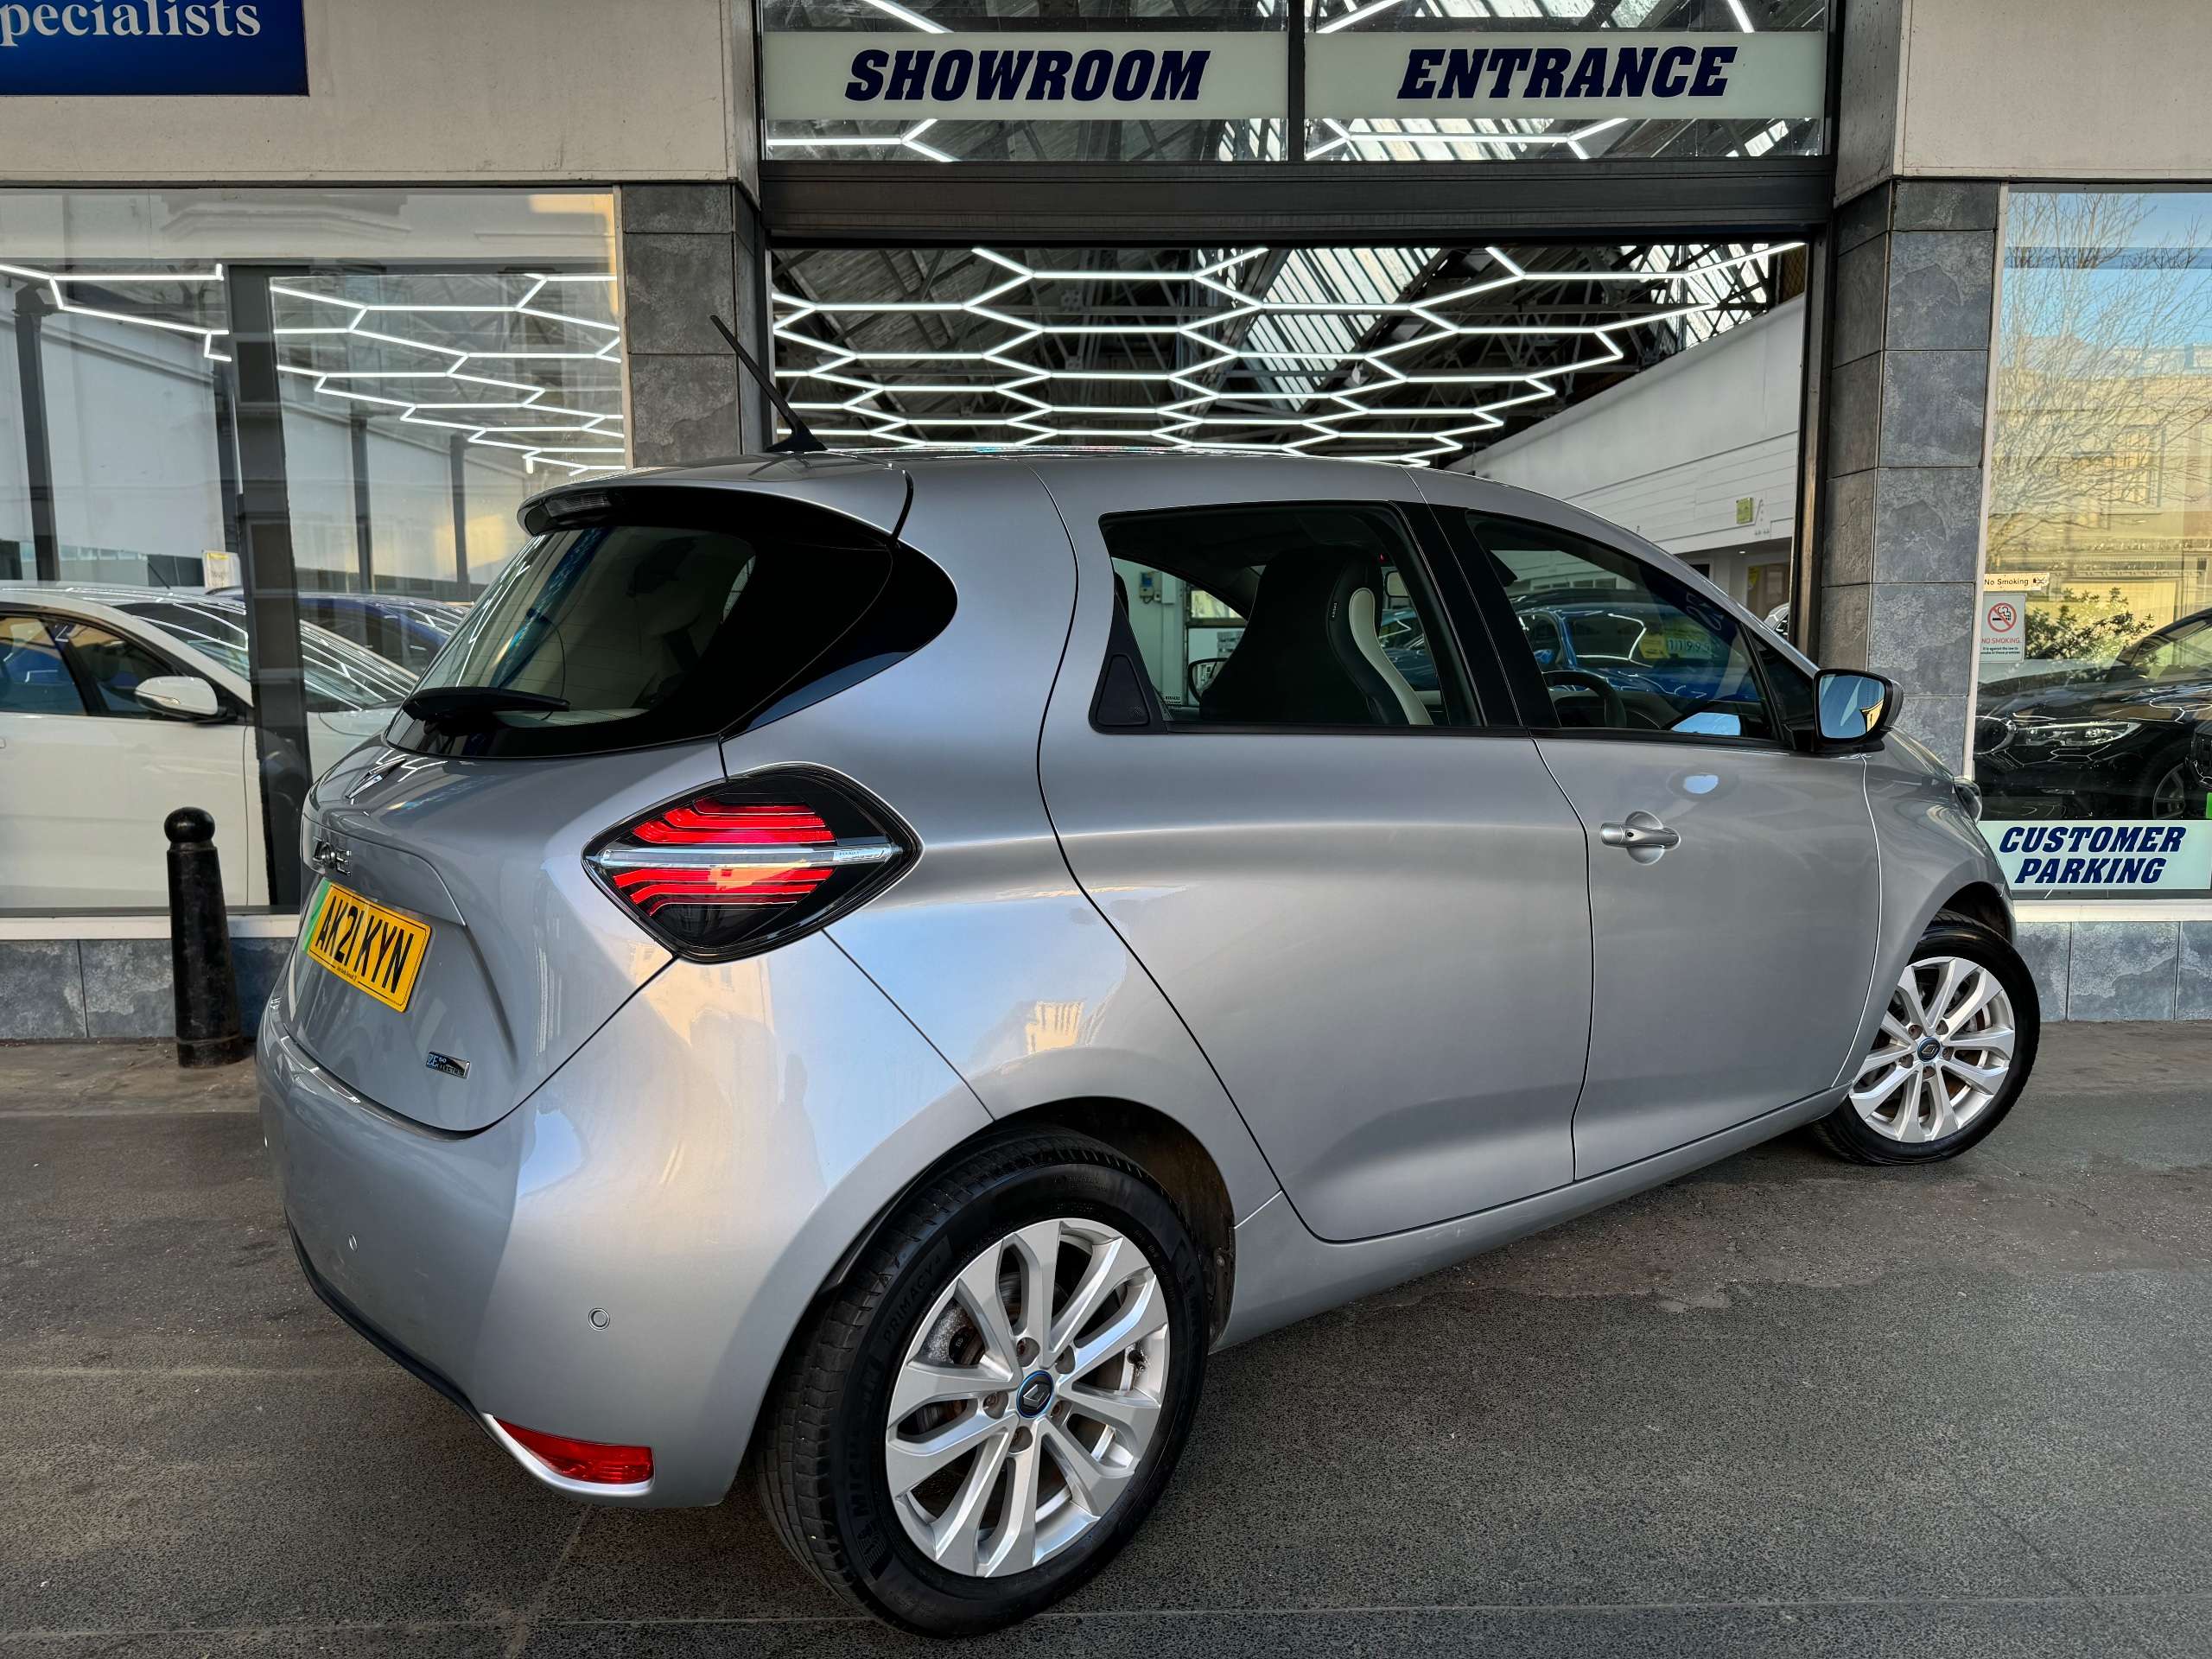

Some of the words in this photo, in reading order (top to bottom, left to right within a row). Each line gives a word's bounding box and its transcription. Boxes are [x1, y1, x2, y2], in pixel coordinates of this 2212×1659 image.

[845, 48, 1211, 102] SHOWROOM
[1397, 46, 1738, 99] ENTRANCE
[1997, 578, 2029, 587] Smoking
[1999, 826, 2187, 854] CUSTOMER
[2014, 857, 2167, 885] PARKING
[315, 896, 365, 967] AK21
[353, 914, 415, 994] KYN
[883, 1263, 933, 1344] PRIMACY
